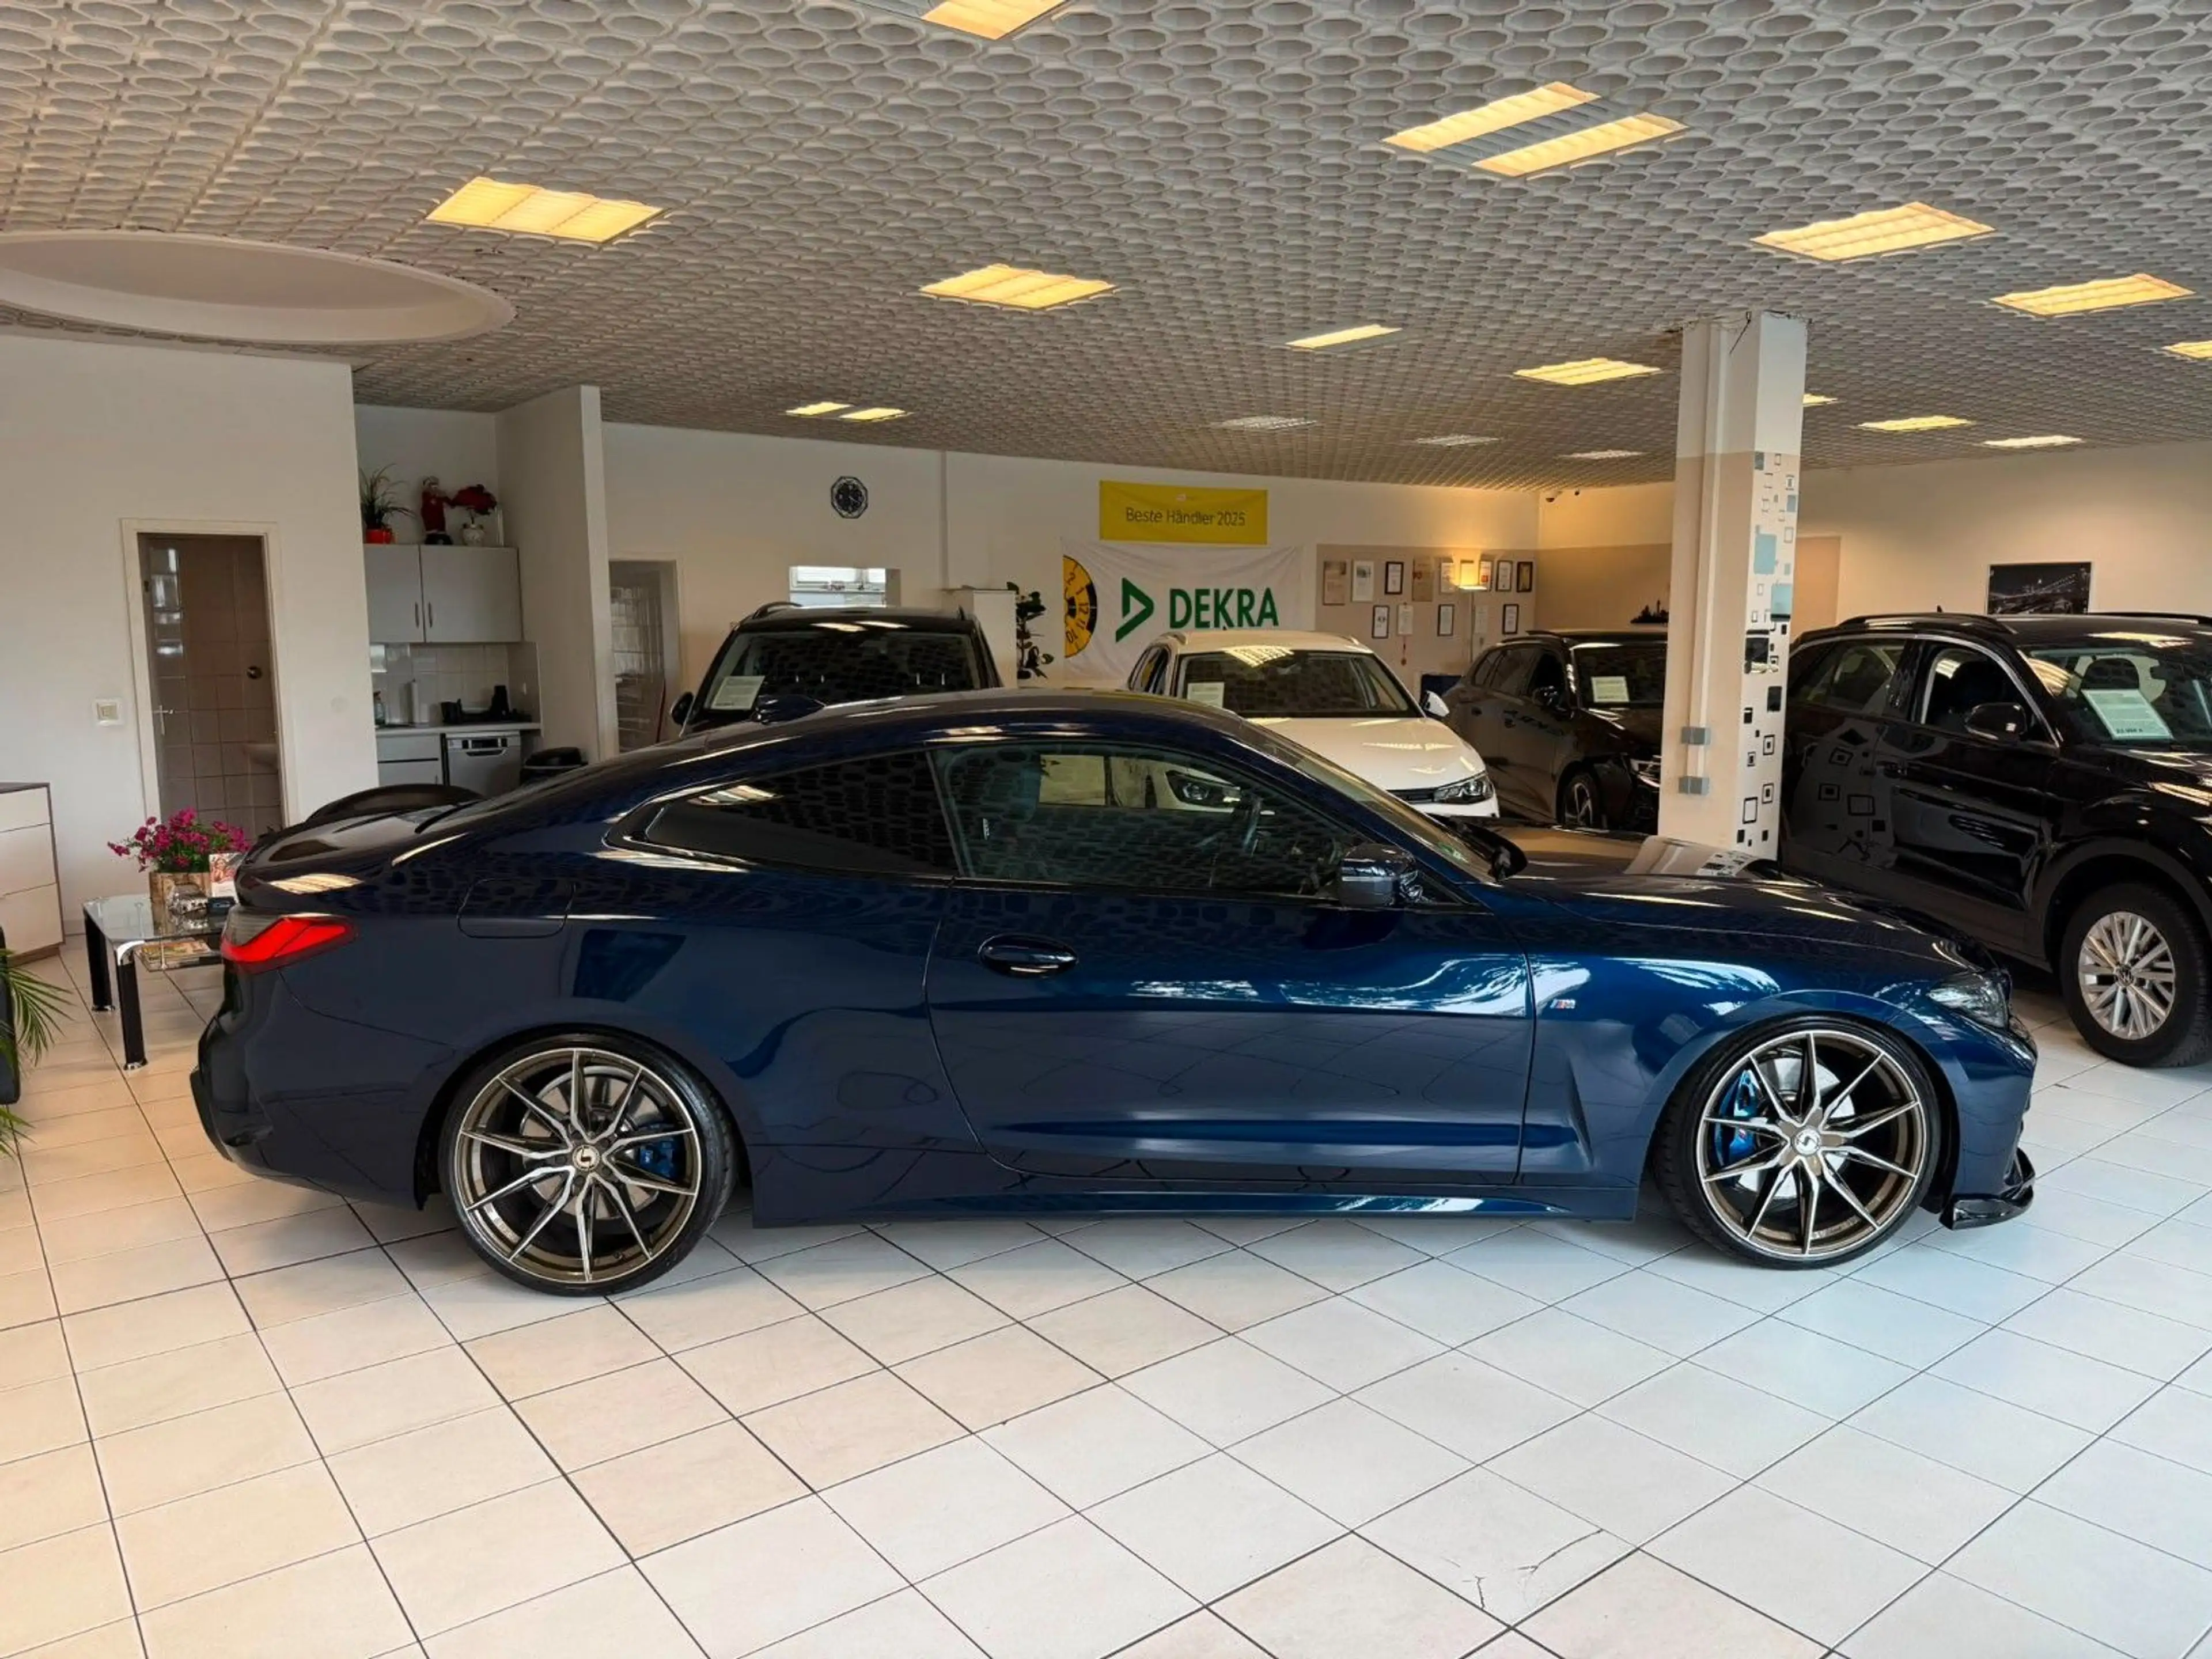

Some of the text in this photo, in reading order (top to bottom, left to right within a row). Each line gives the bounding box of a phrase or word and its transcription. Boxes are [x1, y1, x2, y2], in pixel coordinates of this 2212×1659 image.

[1126, 506, 1162, 522] Beste
[1166, 509, 1215, 525] Händler
[1169, 588, 1279, 629] DEKRA
